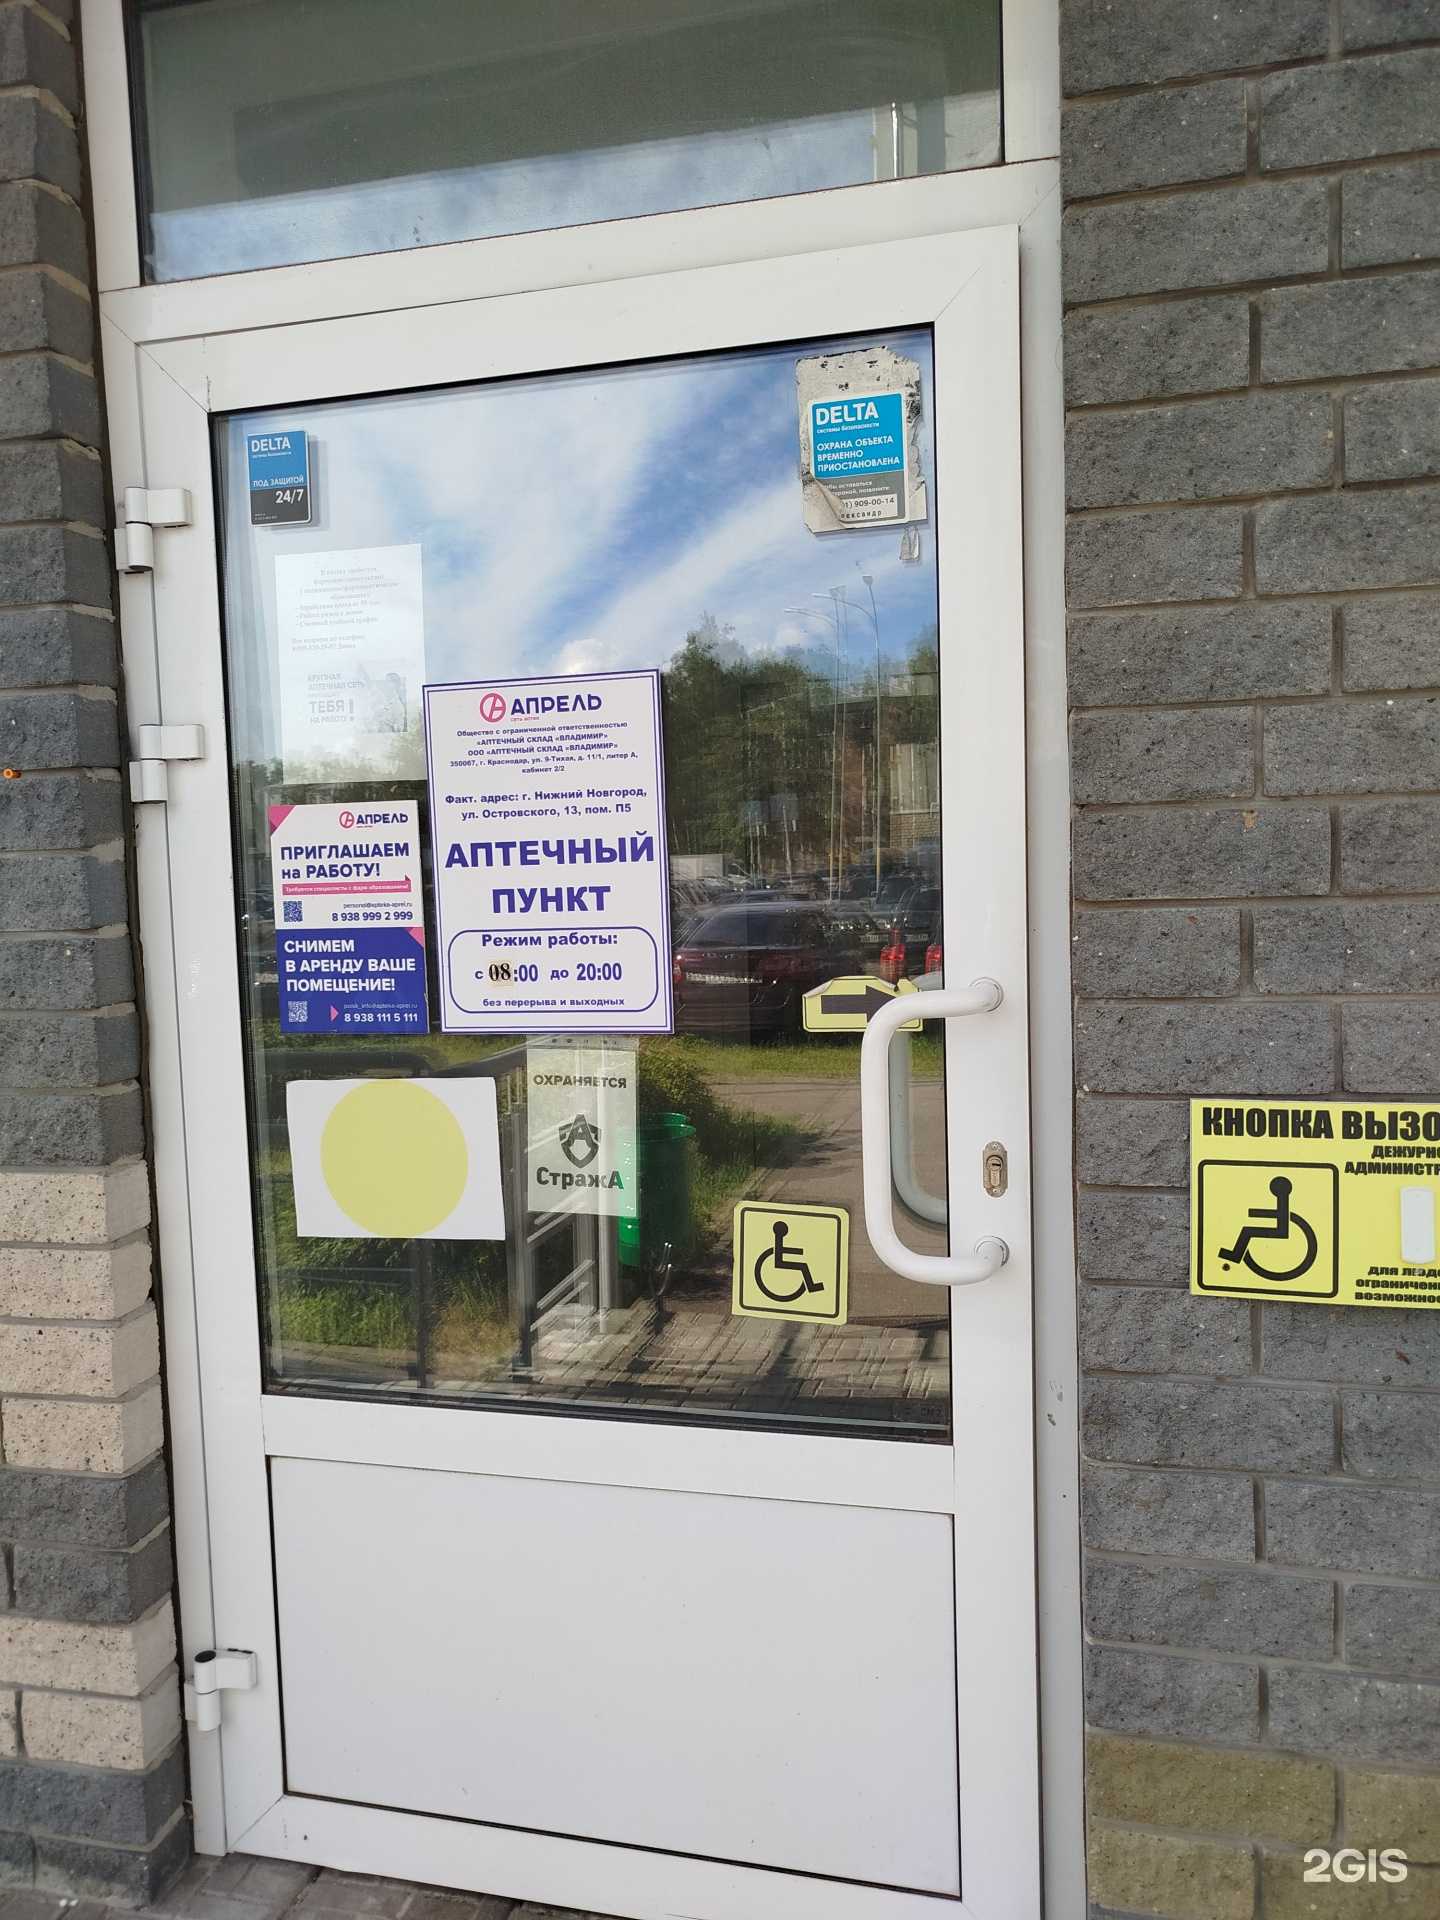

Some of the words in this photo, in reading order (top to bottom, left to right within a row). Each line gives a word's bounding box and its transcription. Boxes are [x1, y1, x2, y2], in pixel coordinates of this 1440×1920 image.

[816, 401, 879, 426] DELTA
[251, 436, 291, 452] DELTA
[817, 440, 852, 451] ОХРАНА
[855, 435, 894, 448] ОБЪЕКТА
[817, 449, 863, 461] ВРЕМЕННО
[818, 456, 900, 472] ПРИОСТАНОВЛЕНА
[252, 479, 269, 488] ПОД
[270, 475, 304, 486] ЗАЩИТОЙ
[275, 488, 304, 504] 24/7
[854, 496, 895, 508] 909-00-14
[510, 694, 603, 716] АПРЕЛЬ
[457, 729, 494, 737] Общество
[502, 726, 556, 735] ограниченной
[558, 722, 628, 731] ответственностью
[477, 736, 525, 745] «АПТЕЧНЫЙ
[555, 733, 608, 742] «ВЛАДИМИР»
[486, 746, 534, 755] «АПТЕЧНЫЙ
[565, 742, 618, 751] «ВЛАДИМИР»
[487, 758, 530, 766] Краснодар,
[522, 766, 552, 774] кабинет
[445, 794, 477, 804] Факт.
[480, 793, 519, 804] адрес:
[535, 789, 583, 801] Нижний
[587, 787, 647, 800] Новгород,
[356, 813, 408, 825] АПРЕЛЬ
[461, 811, 479, 821] ул.
[482, 807, 560, 820] Островского,
[564, 805, 582, 816] 13,
[585, 805, 612, 815] пом.
[615, 803, 631, 813] П5
[280, 842, 409, 860] ПРИГЛАШАЕМ
[445, 830, 655, 869] АПТЕЧНЫЙ
[281, 868, 300, 879] на
[306, 863, 380, 879] РАБОТУ!
[492, 885, 611, 914] ПУНКТ
[332, 912, 338, 921] 8
[341, 912, 360, 921] 938
[362, 911, 382, 921] 999
[385, 911, 390, 921] 2
[393, 911, 413, 920] 999
[284, 939, 354, 953] СНИМЕМ
[481, 934, 542, 947] Режим
[548, 932, 618, 948] работы:
[285, 960, 296, 972] В
[300, 959, 363, 974] АРЕНДУ
[368, 958, 416, 971] ВАШЕ
[474, 970, 484, 980] с
[488, 963, 539, 982] 08:00
[550, 968, 569, 980] до
[576, 963, 622, 981] 20:00
[286, 978, 396, 993] ПОМЕЩЕНИЕ!
[482, 999, 501, 1007] без
[505, 999, 557, 1008] перерыва
[570, 998, 625, 1007] выходных
[344, 1013, 351, 1022] 8
[353, 1013, 374, 1022] 938
[377, 1013, 391, 1022] 111
[394, 1013, 400, 1022] 5
[403, 1013, 418, 1022] 111
[533, 1074, 627, 1088] ОХРАНЯЕТСЯ
[1202, 1107, 1334, 1139] КНОПКА
[536, 1166, 624, 1190] СтражА
[1368, 1266, 1398, 1276] для
